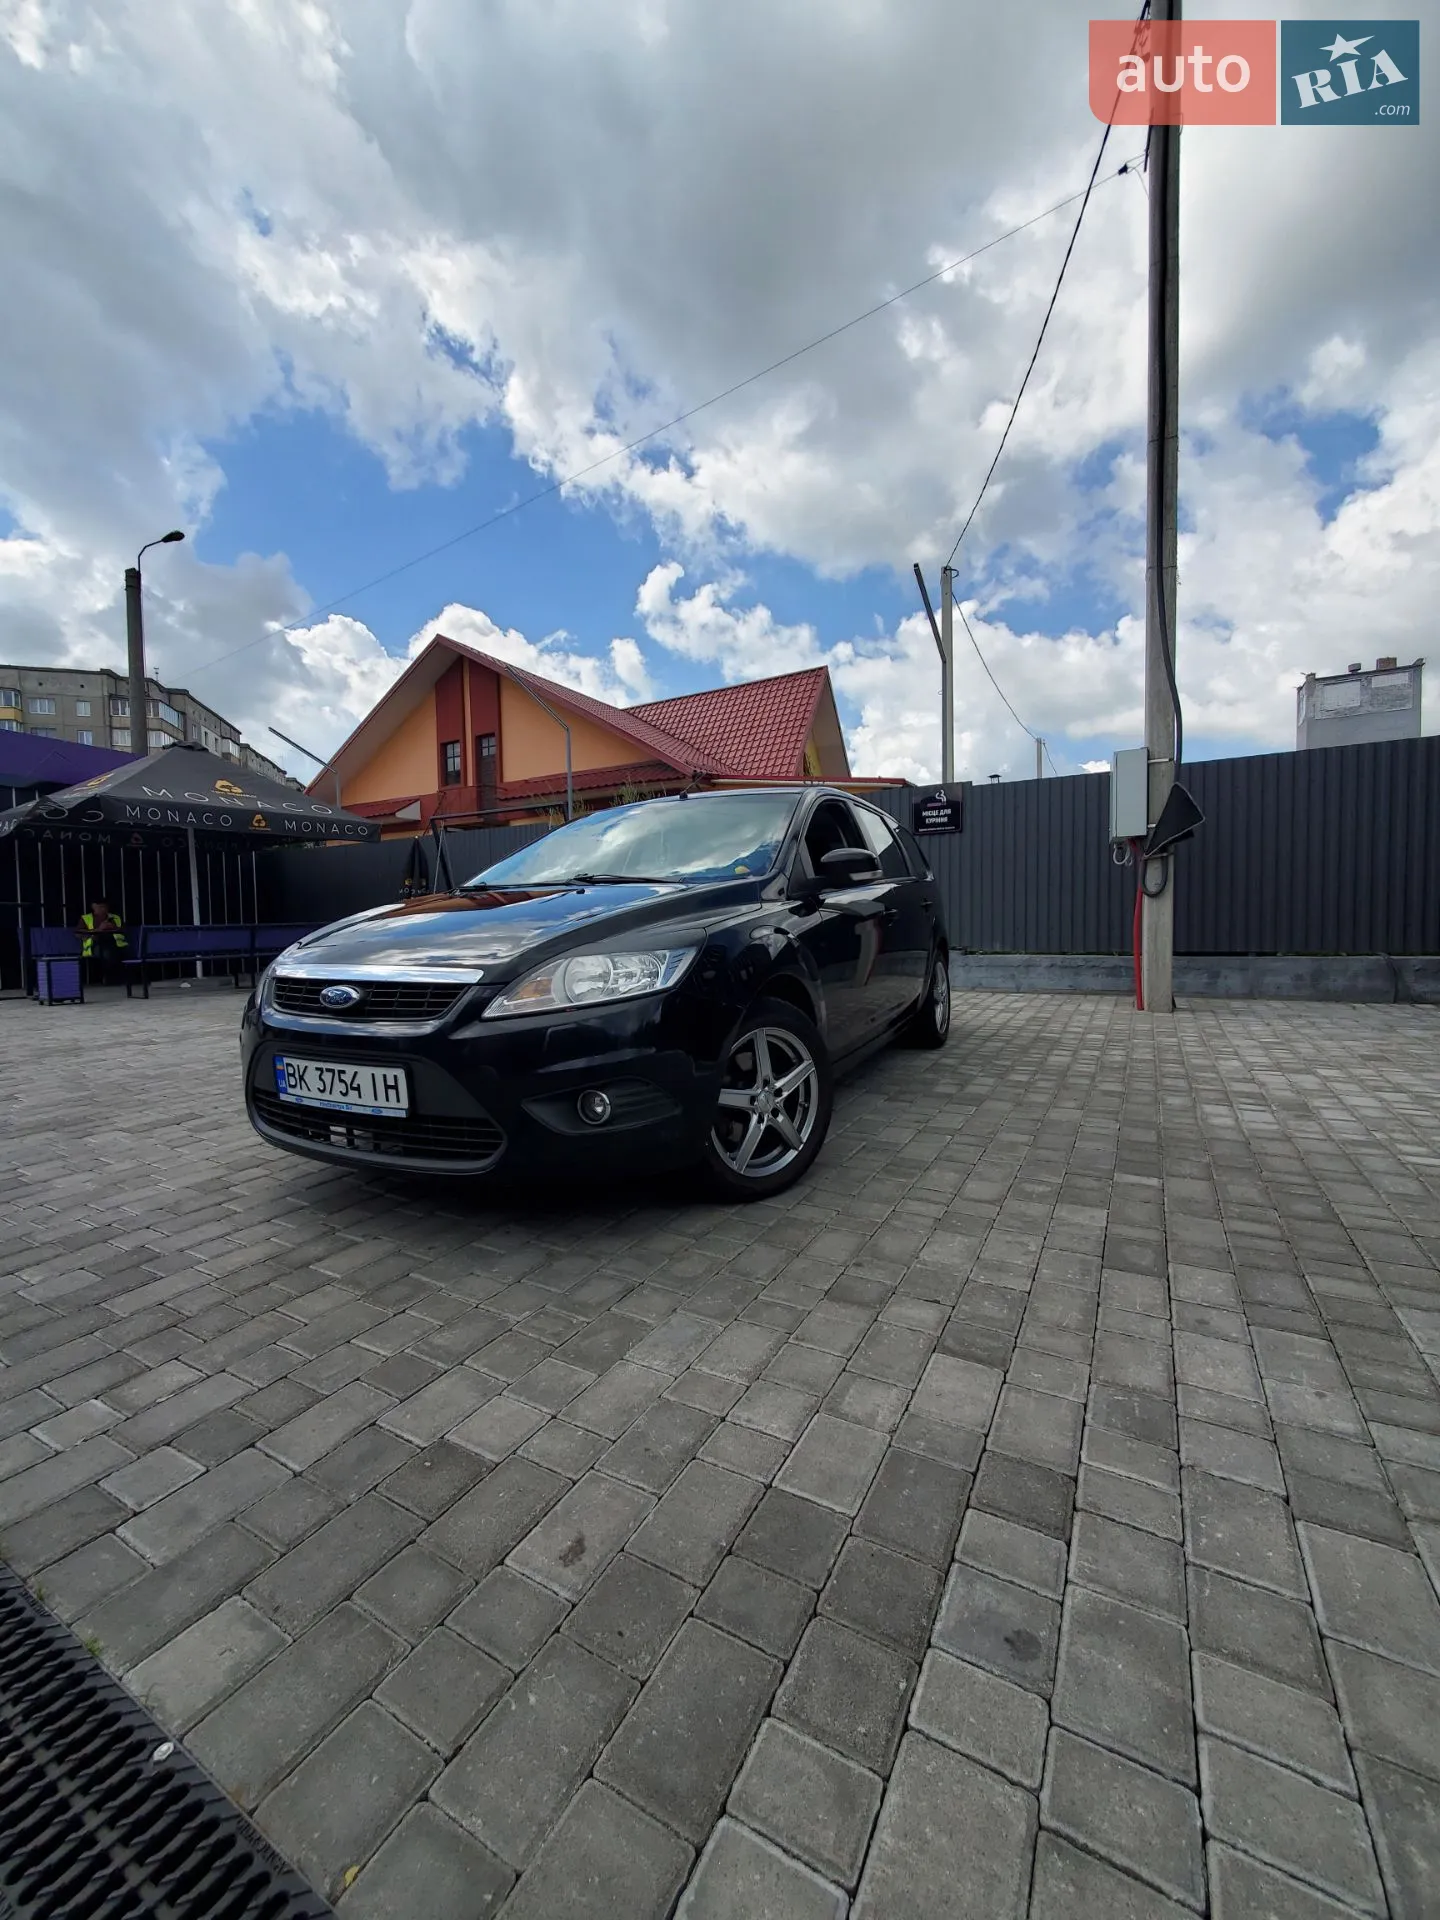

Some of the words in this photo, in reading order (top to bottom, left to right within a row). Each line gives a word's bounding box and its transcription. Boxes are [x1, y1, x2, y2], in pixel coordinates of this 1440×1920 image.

[142, 784, 332, 815] MONACO
[126, 804, 233, 827] MONACO
[284, 819, 368, 836] MONACO
[314, 1066, 363, 1100] 3754
